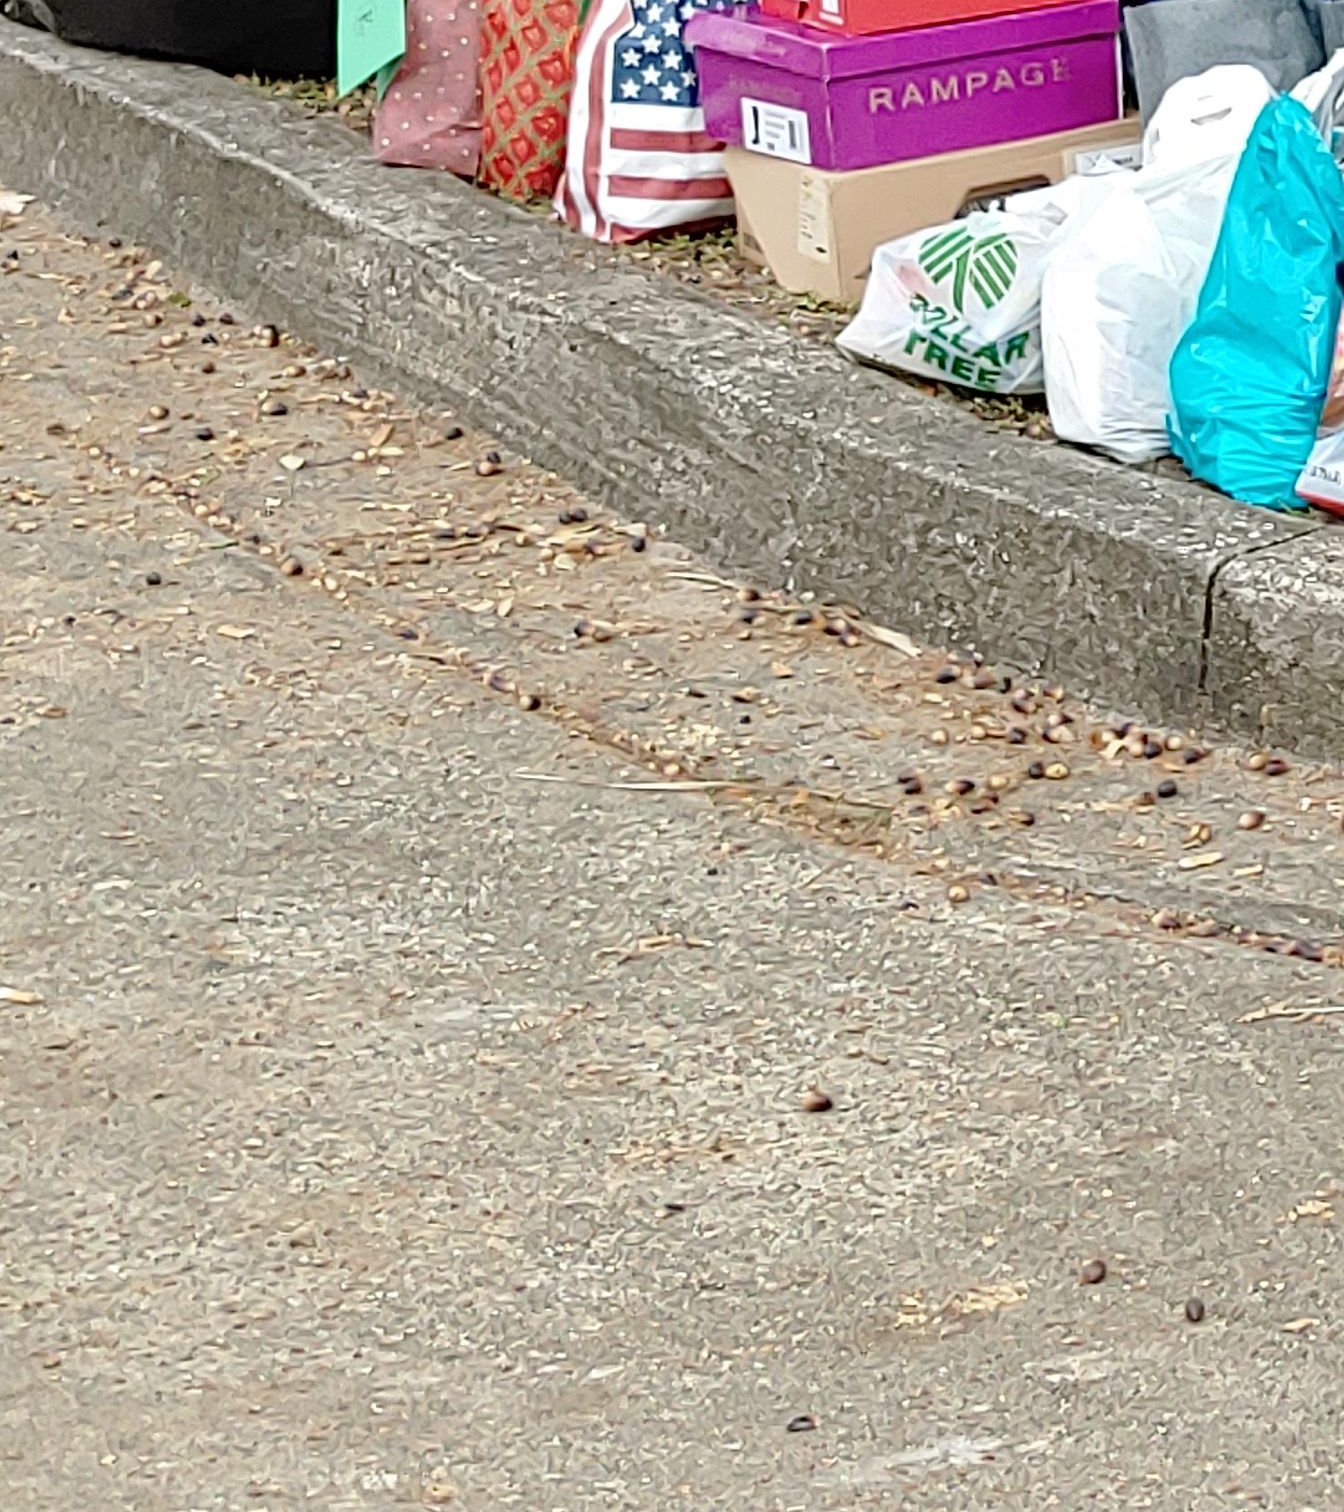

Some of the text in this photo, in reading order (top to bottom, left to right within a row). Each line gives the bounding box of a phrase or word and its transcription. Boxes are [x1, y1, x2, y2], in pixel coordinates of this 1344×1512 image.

[869, 58, 1072, 114] RAMPAGE
[903, 330, 1001, 387] TREE
[909, 293, 1030, 368] DOLLAR
